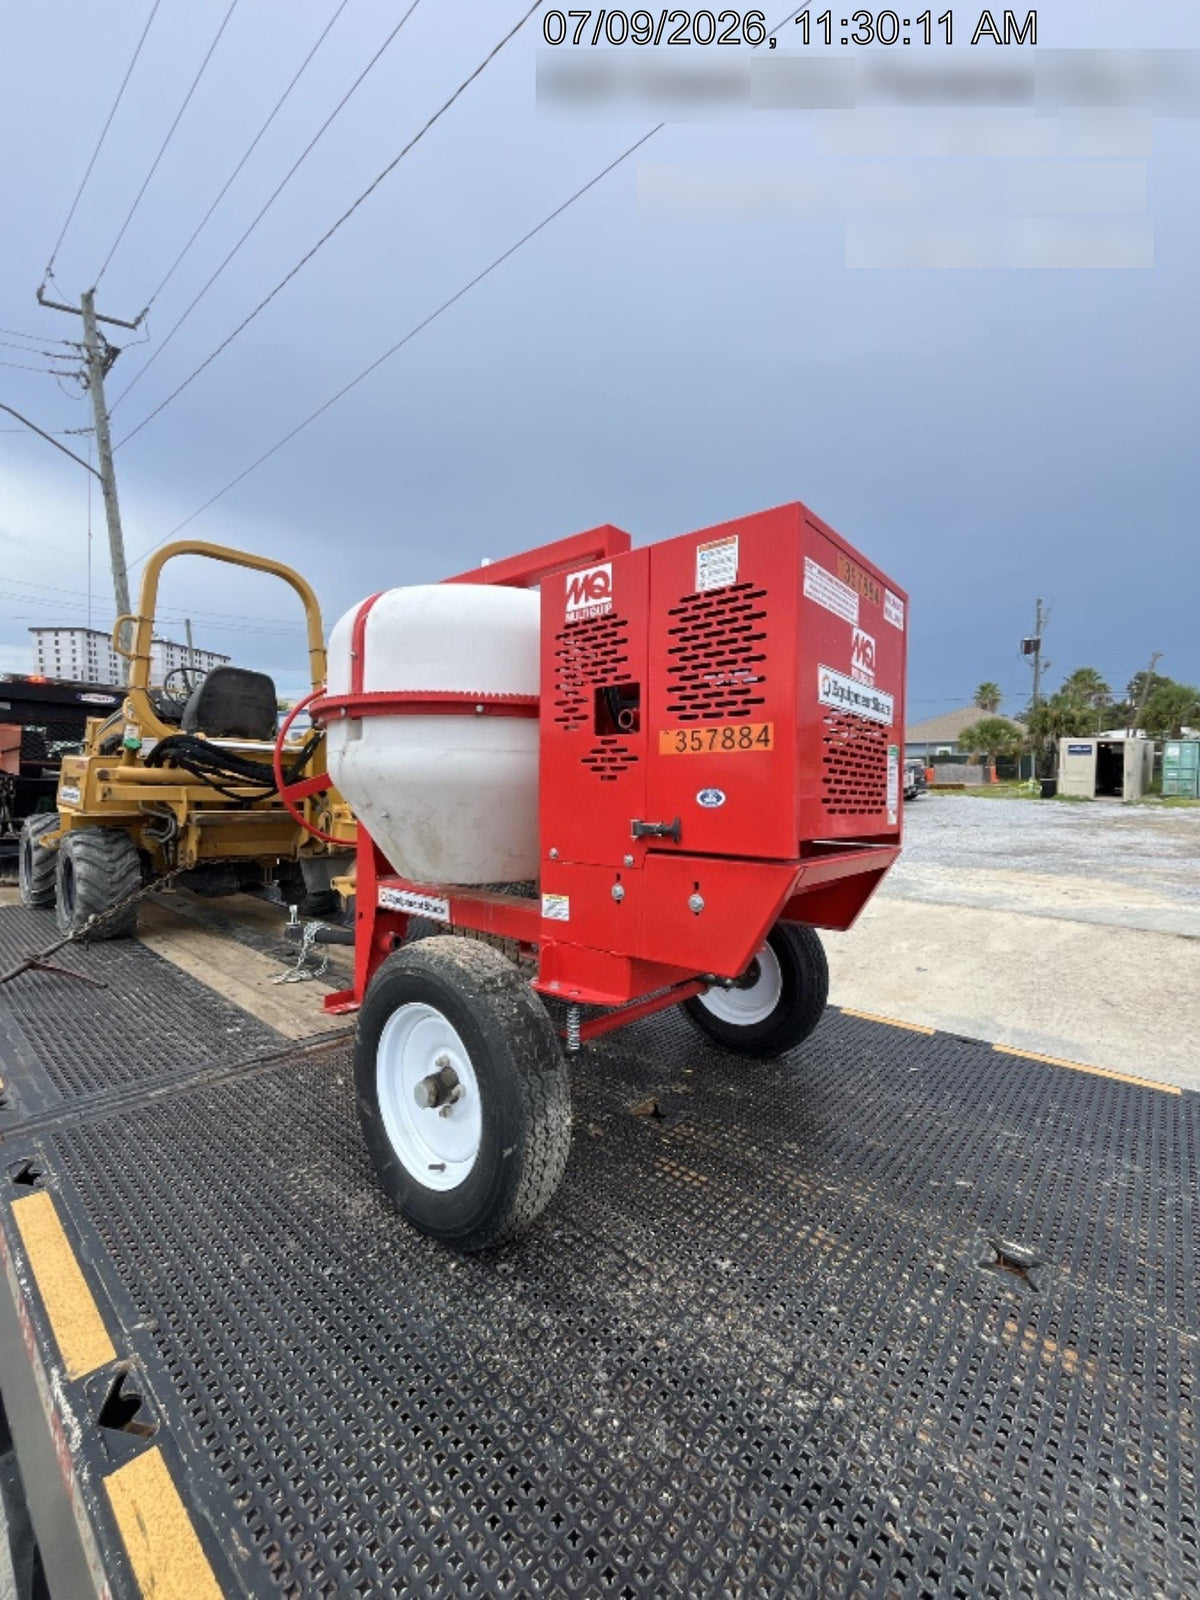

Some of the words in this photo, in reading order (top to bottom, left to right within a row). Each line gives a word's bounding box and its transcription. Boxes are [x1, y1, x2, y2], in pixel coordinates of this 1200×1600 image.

[566, 568, 612, 606] MQ
[851, 630, 876, 673] MQ
[675, 724, 771, 753] 357884
